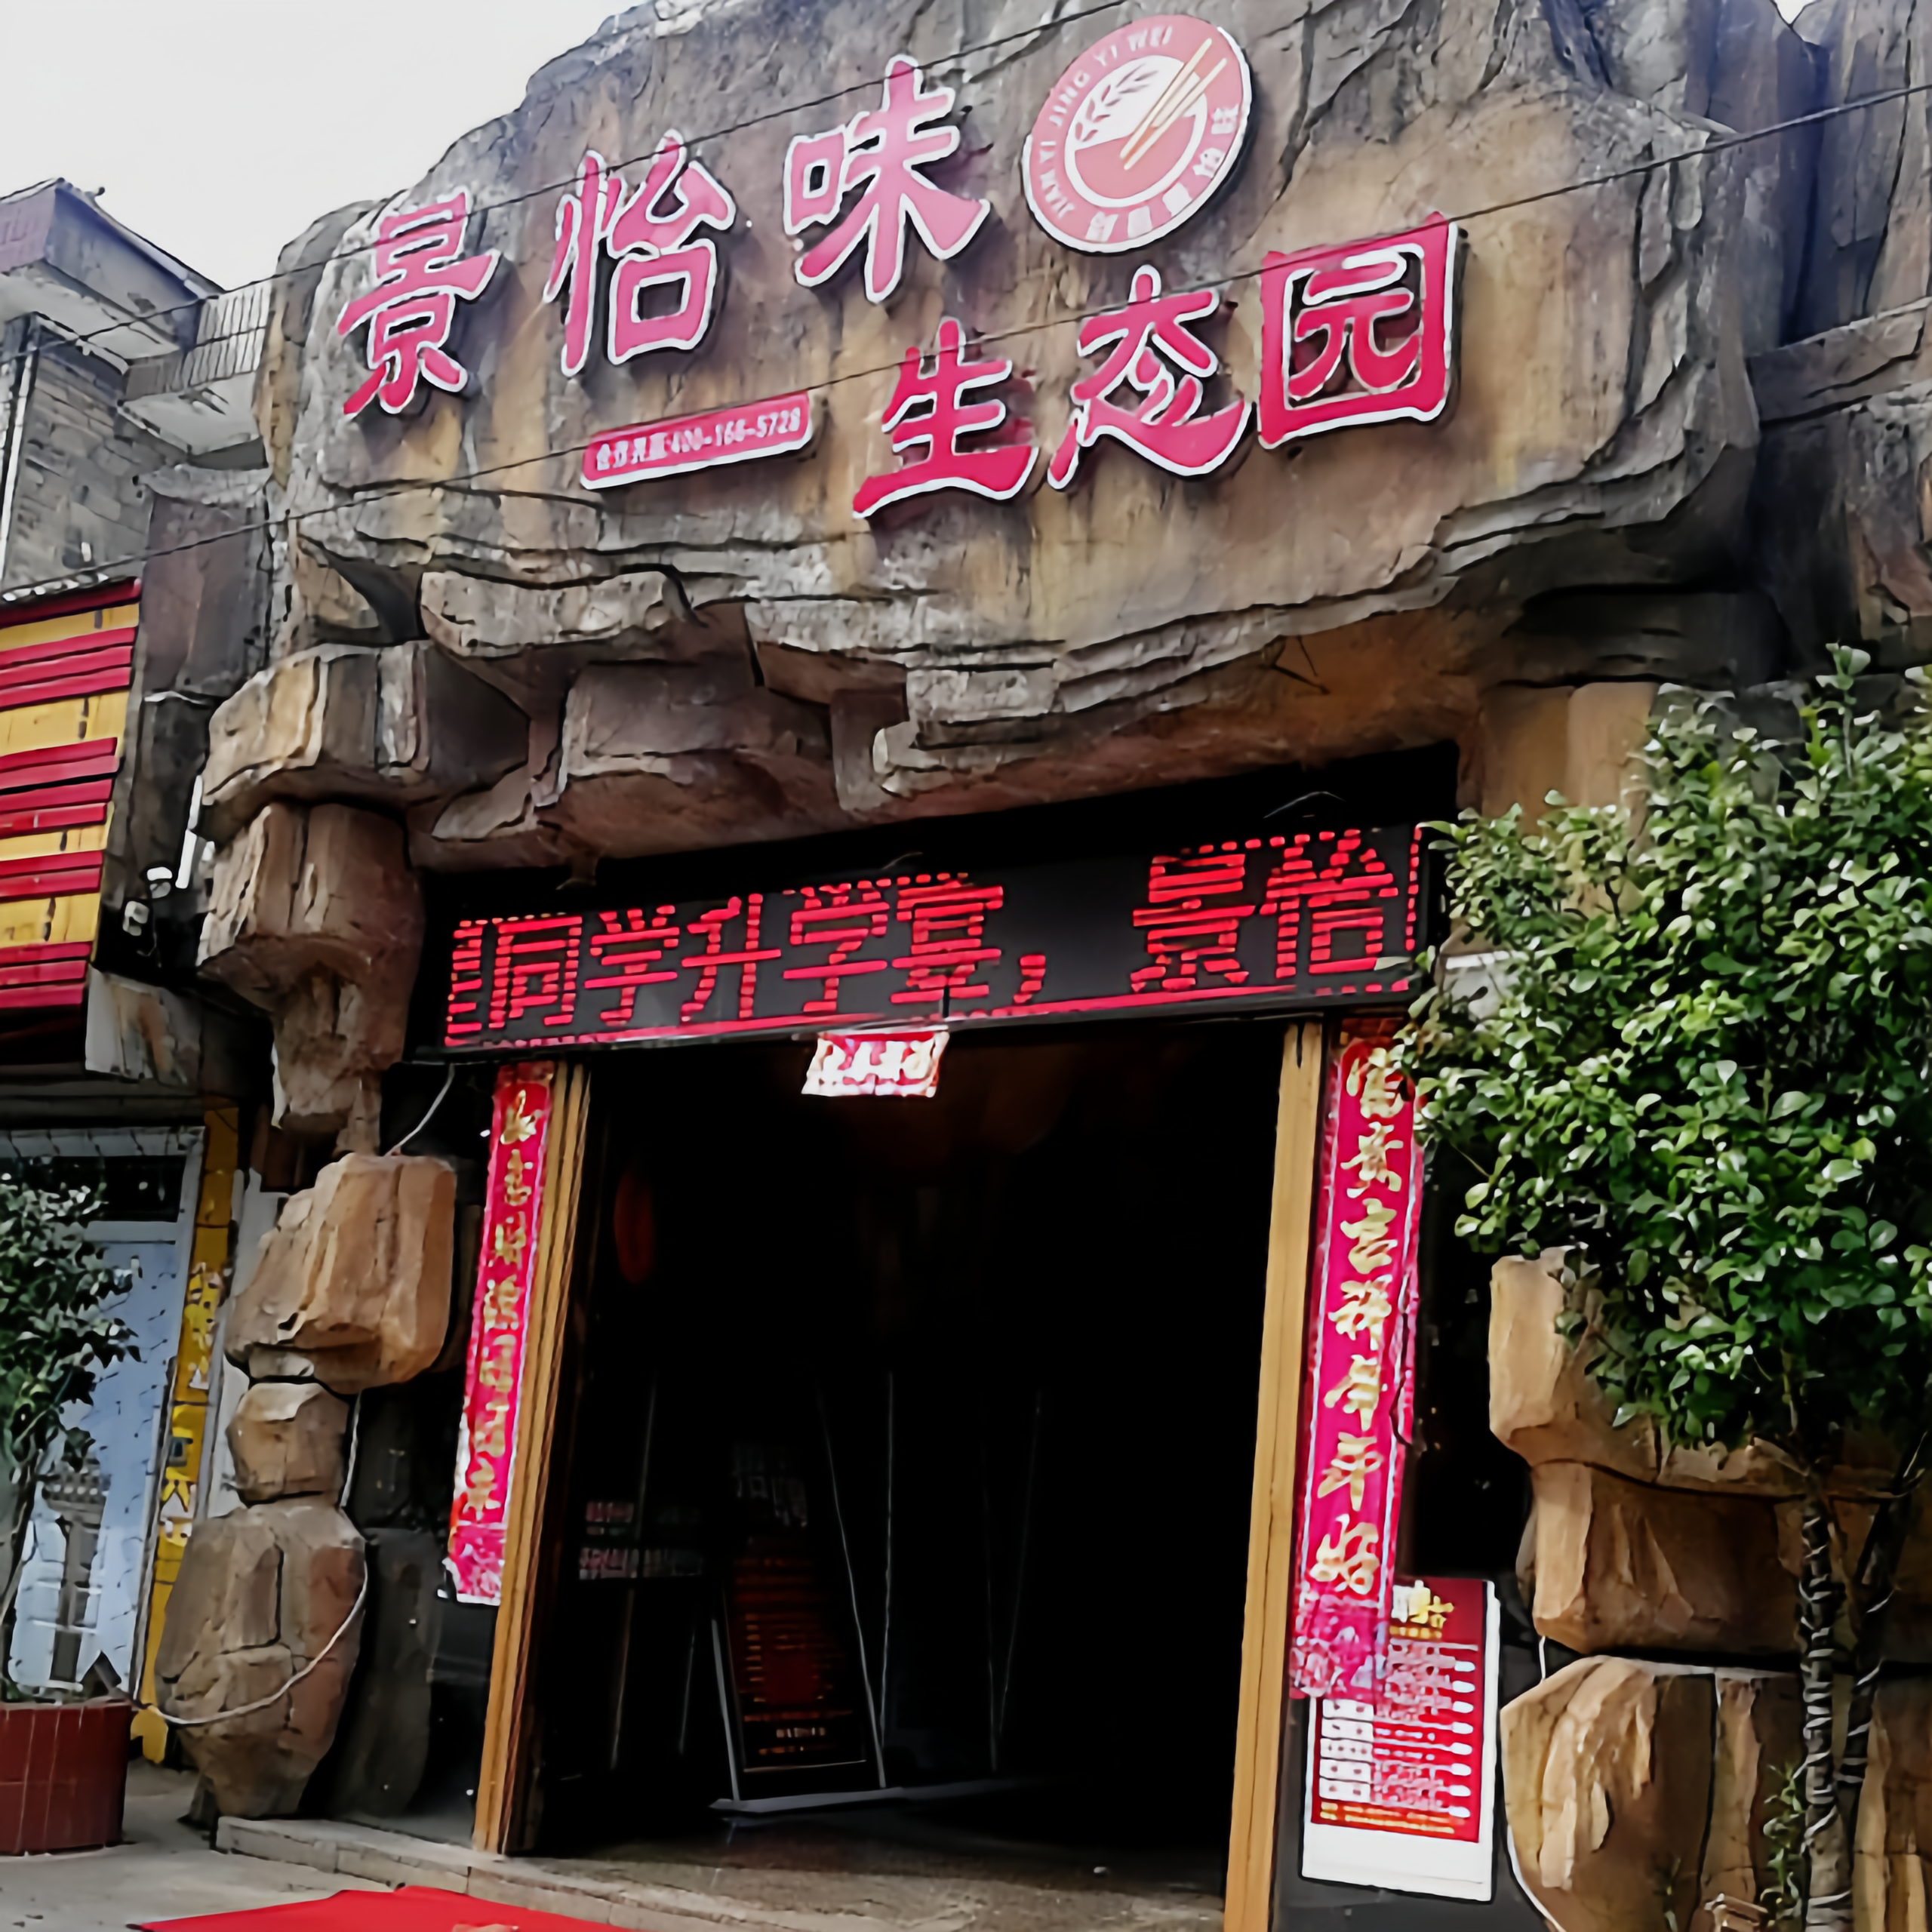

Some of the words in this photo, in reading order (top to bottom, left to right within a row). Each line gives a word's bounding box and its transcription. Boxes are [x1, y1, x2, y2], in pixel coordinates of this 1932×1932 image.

[337, 56, 991, 417] 景怡味
[851, 210, 1463, 519] 生态园
